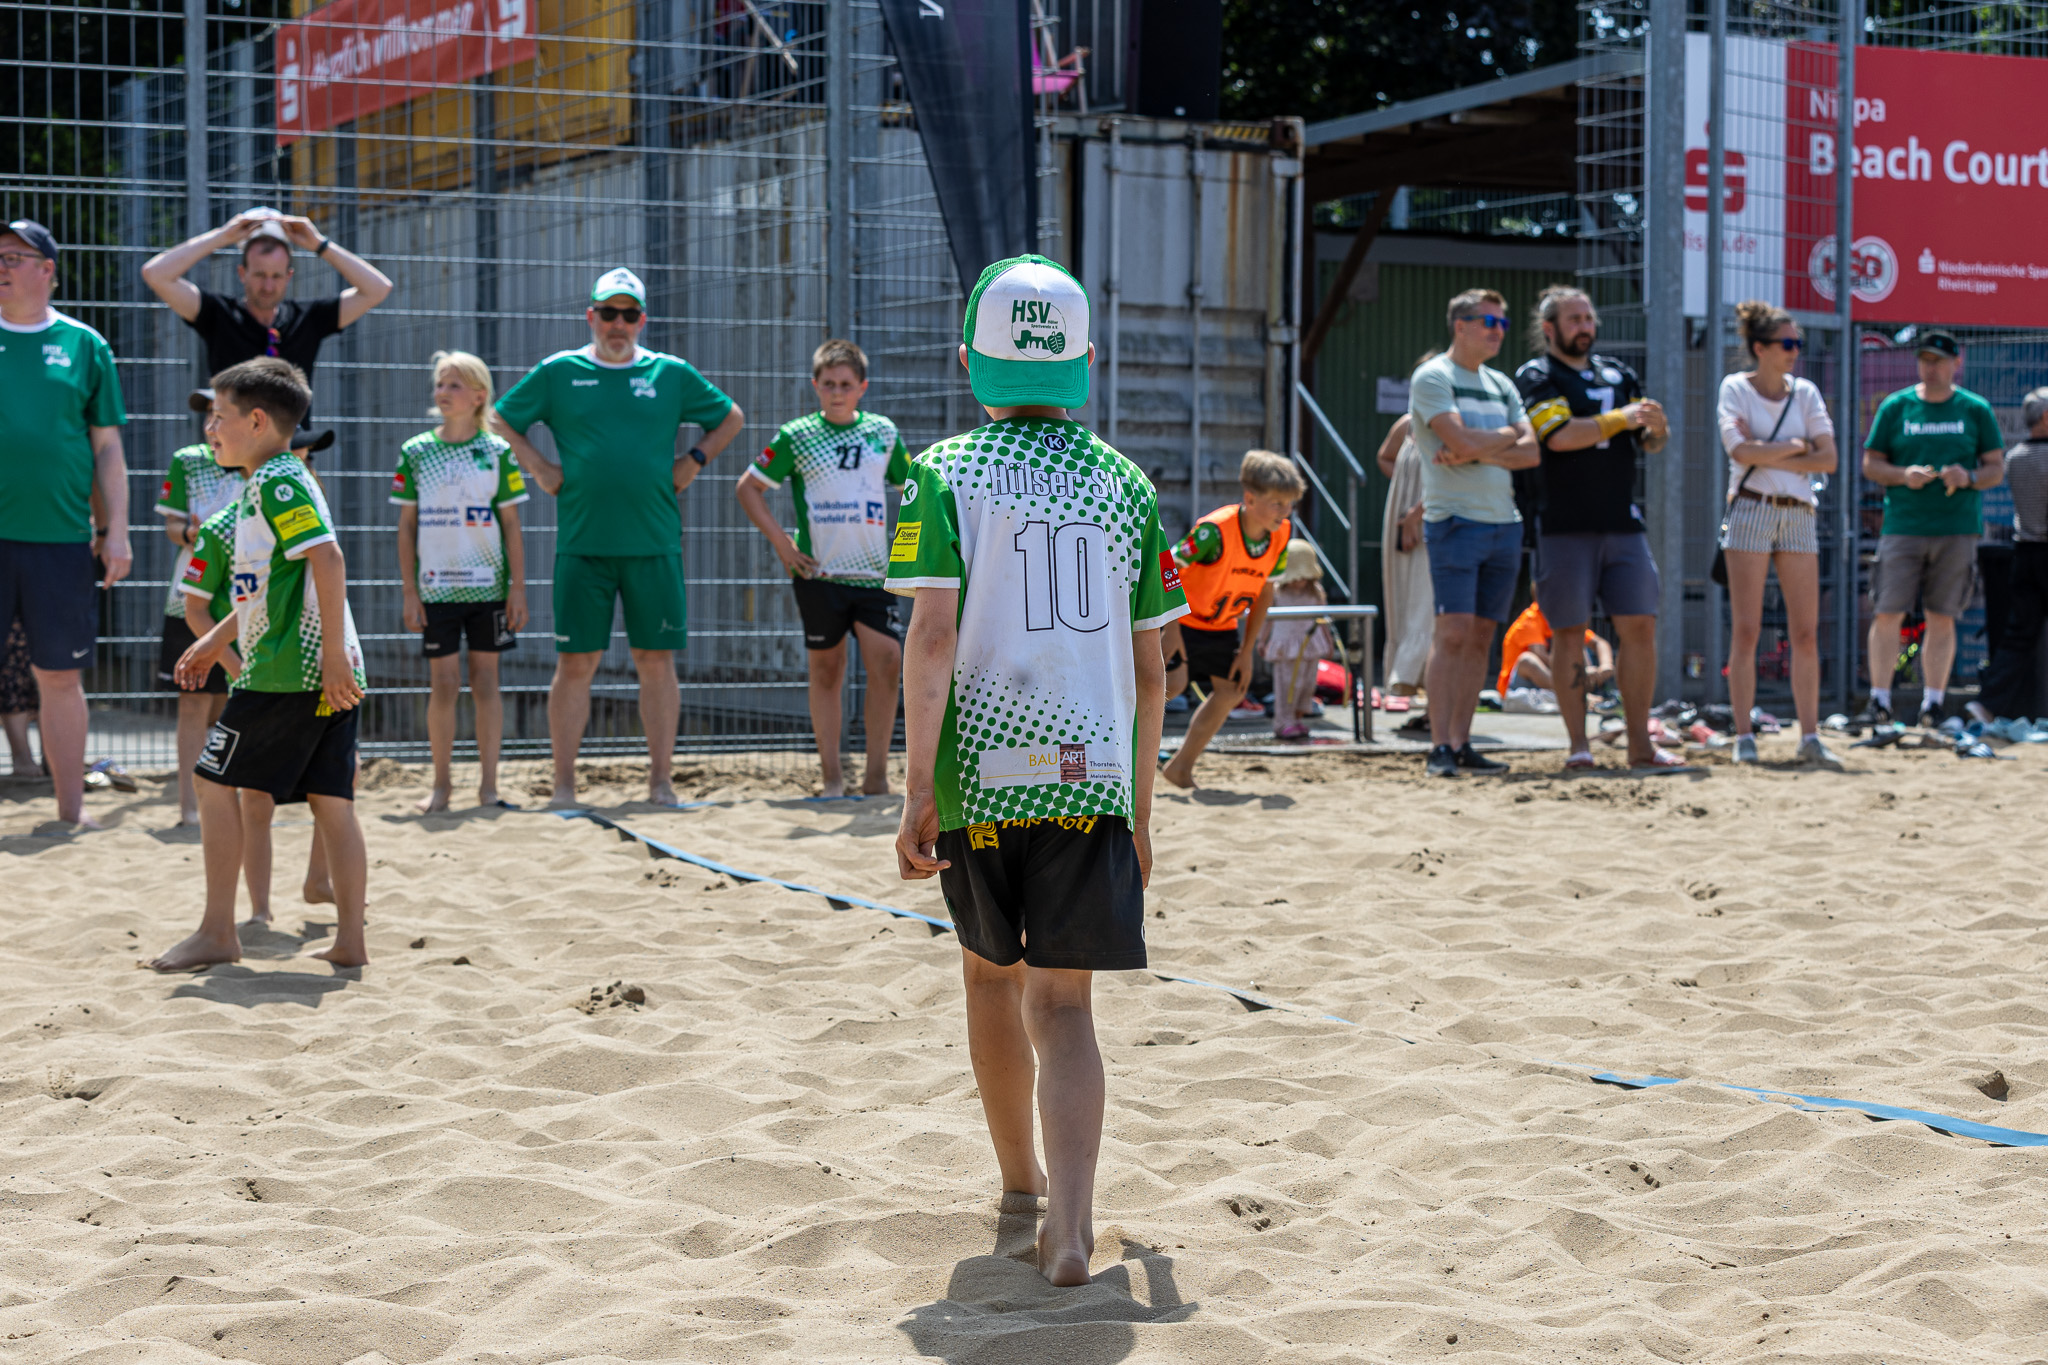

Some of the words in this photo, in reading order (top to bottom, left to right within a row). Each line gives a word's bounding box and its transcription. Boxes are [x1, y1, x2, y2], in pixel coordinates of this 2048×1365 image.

[1809, 87, 1886, 127] Nipa
[1943, 140, 2048, 189] Court
[1011, 299, 1051, 324] HSV
[1903, 420, 1965, 436] hummel
[836, 445, 862, 470] 27
[988, 462, 1083, 498] Hülser
[1090, 468, 1123, 504] SV
[419, 506, 459, 515] olksbank
[1014, 521, 1110, 633] 10
[1089, 760, 1117, 768] Thorsten
